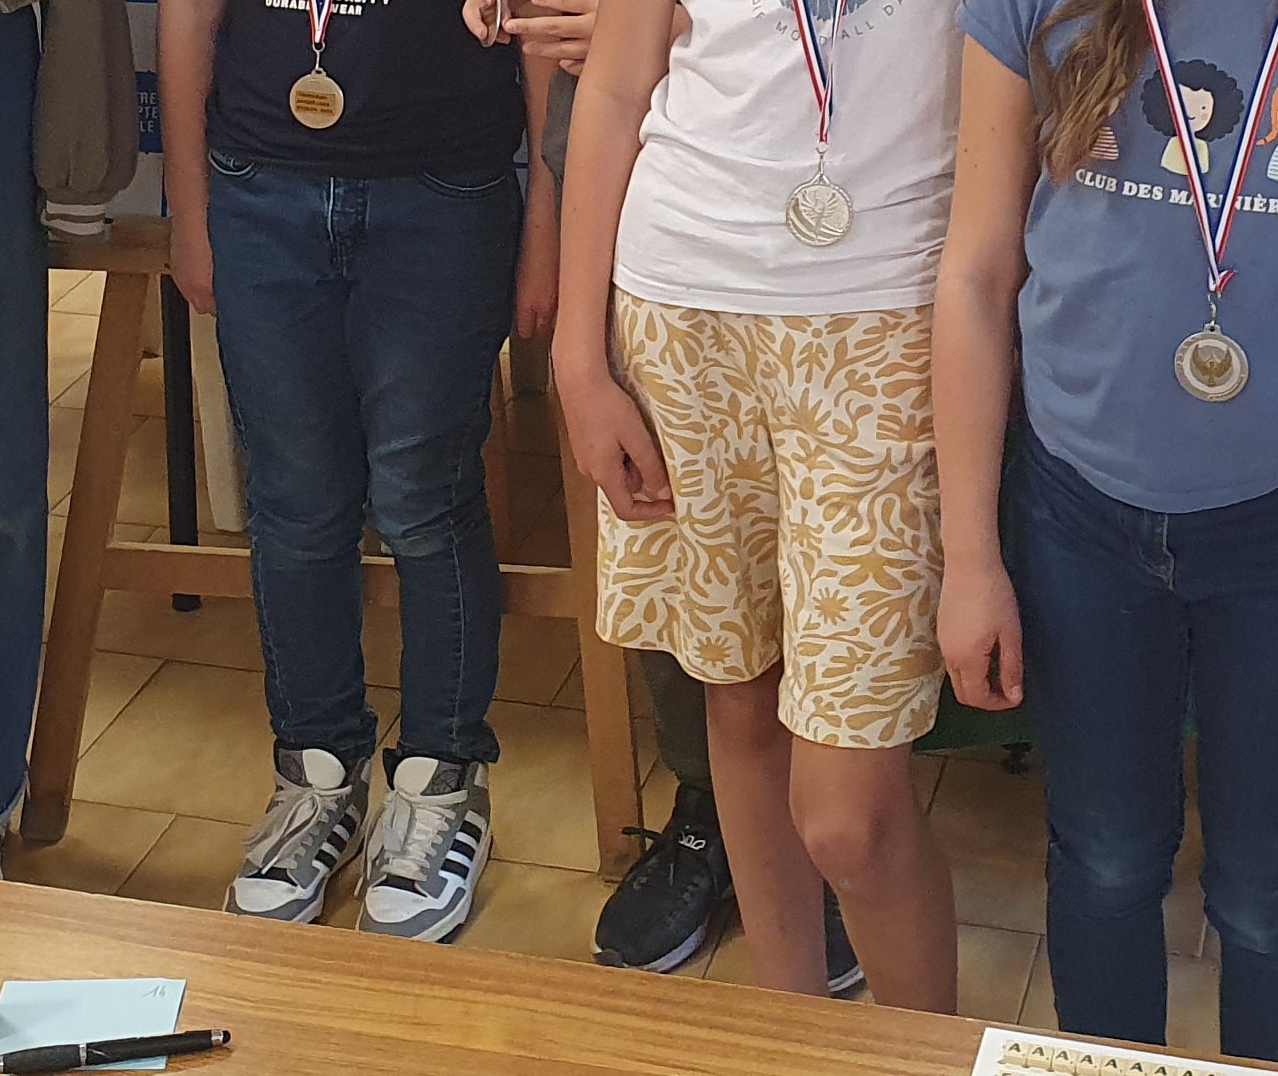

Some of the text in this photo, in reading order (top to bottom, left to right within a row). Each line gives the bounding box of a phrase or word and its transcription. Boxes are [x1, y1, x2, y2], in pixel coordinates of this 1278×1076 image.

[775, 20, 827, 46] MOD
[841, 20, 874, 40] ALL
[1075, 168, 1118, 192] CLUB
[1122, 181, 1164, 201] DES
[1008, 1043, 1021, 1052] A
[1032, 1047, 1045, 1056] A
[1055, 1051, 1069, 1060] A
[1080, 1055, 1093, 1064] A
[1105, 1059, 1118, 1068] A
[1130, 1063, 1143, 1072] A
[1154, 1066, 1167, 1075] A
